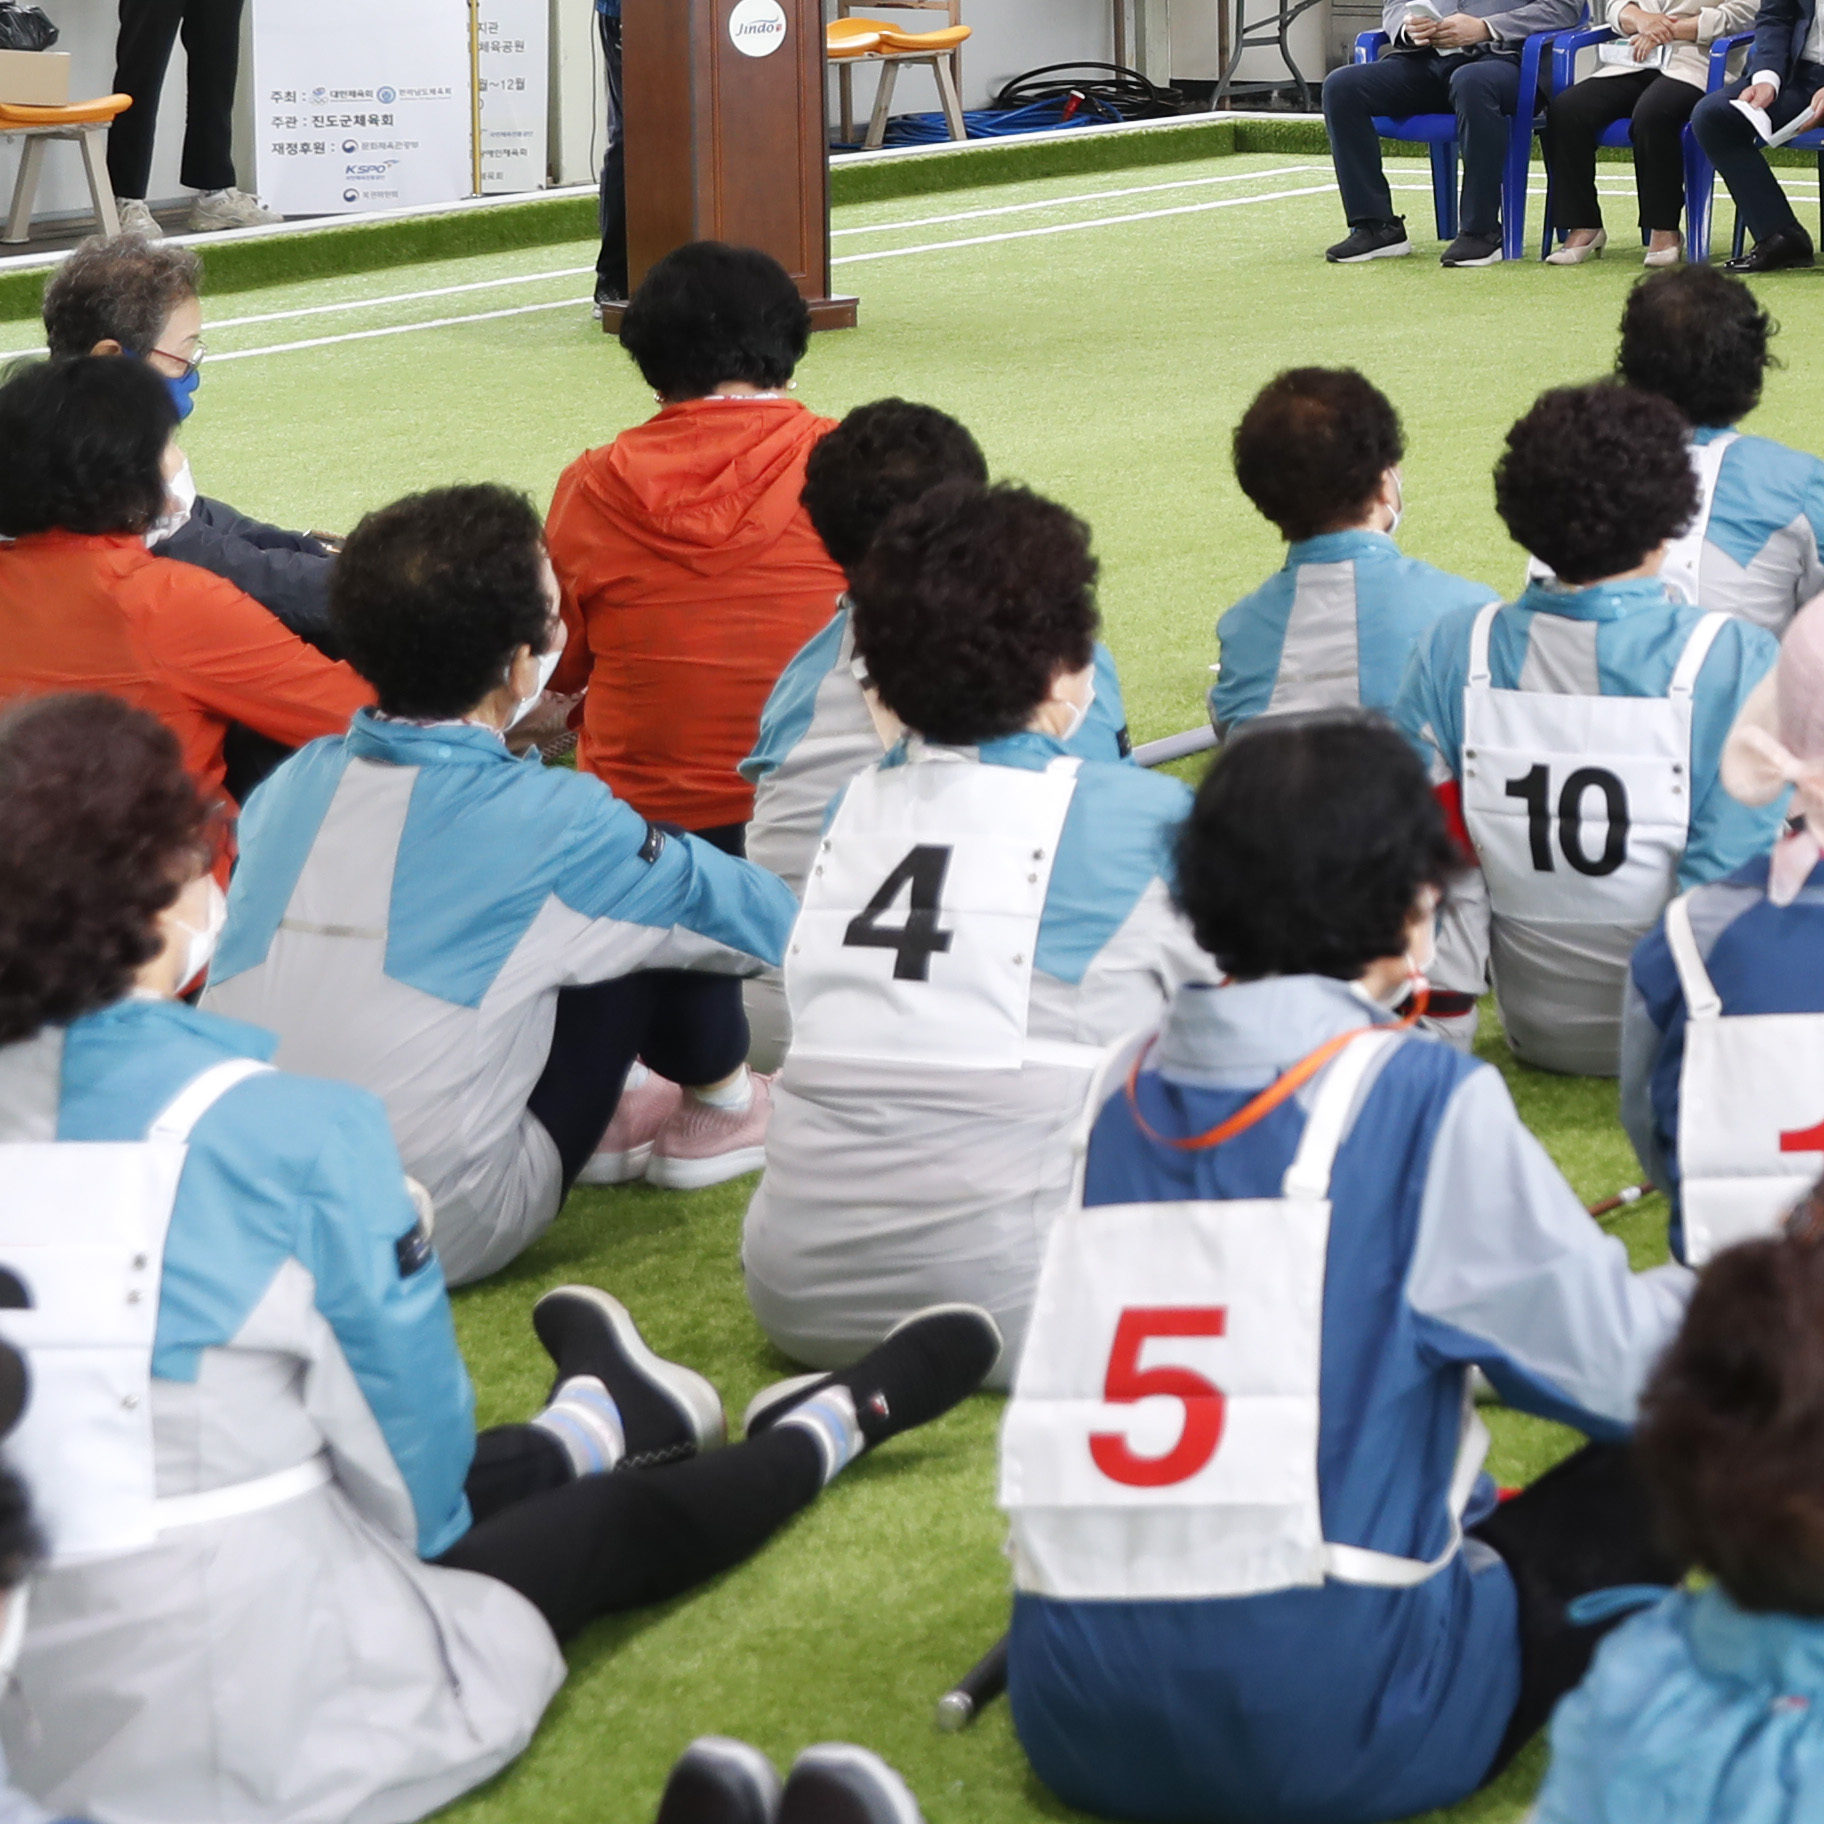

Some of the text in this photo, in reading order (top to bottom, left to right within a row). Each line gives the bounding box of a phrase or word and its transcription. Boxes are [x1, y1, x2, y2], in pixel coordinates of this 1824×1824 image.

[735, 21, 775, 36] Jindo
[271, 91, 296, 103] 주최
[271, 114, 394, 128] 주관 진도군체육회
[271, 142, 325, 155] 재정후원
[345, 165, 386, 174] KSPO
[1499, 758, 1637, 880] 10
[843, 845, 951, 981] 4
[1084, 1299, 1231, 1492] 5
